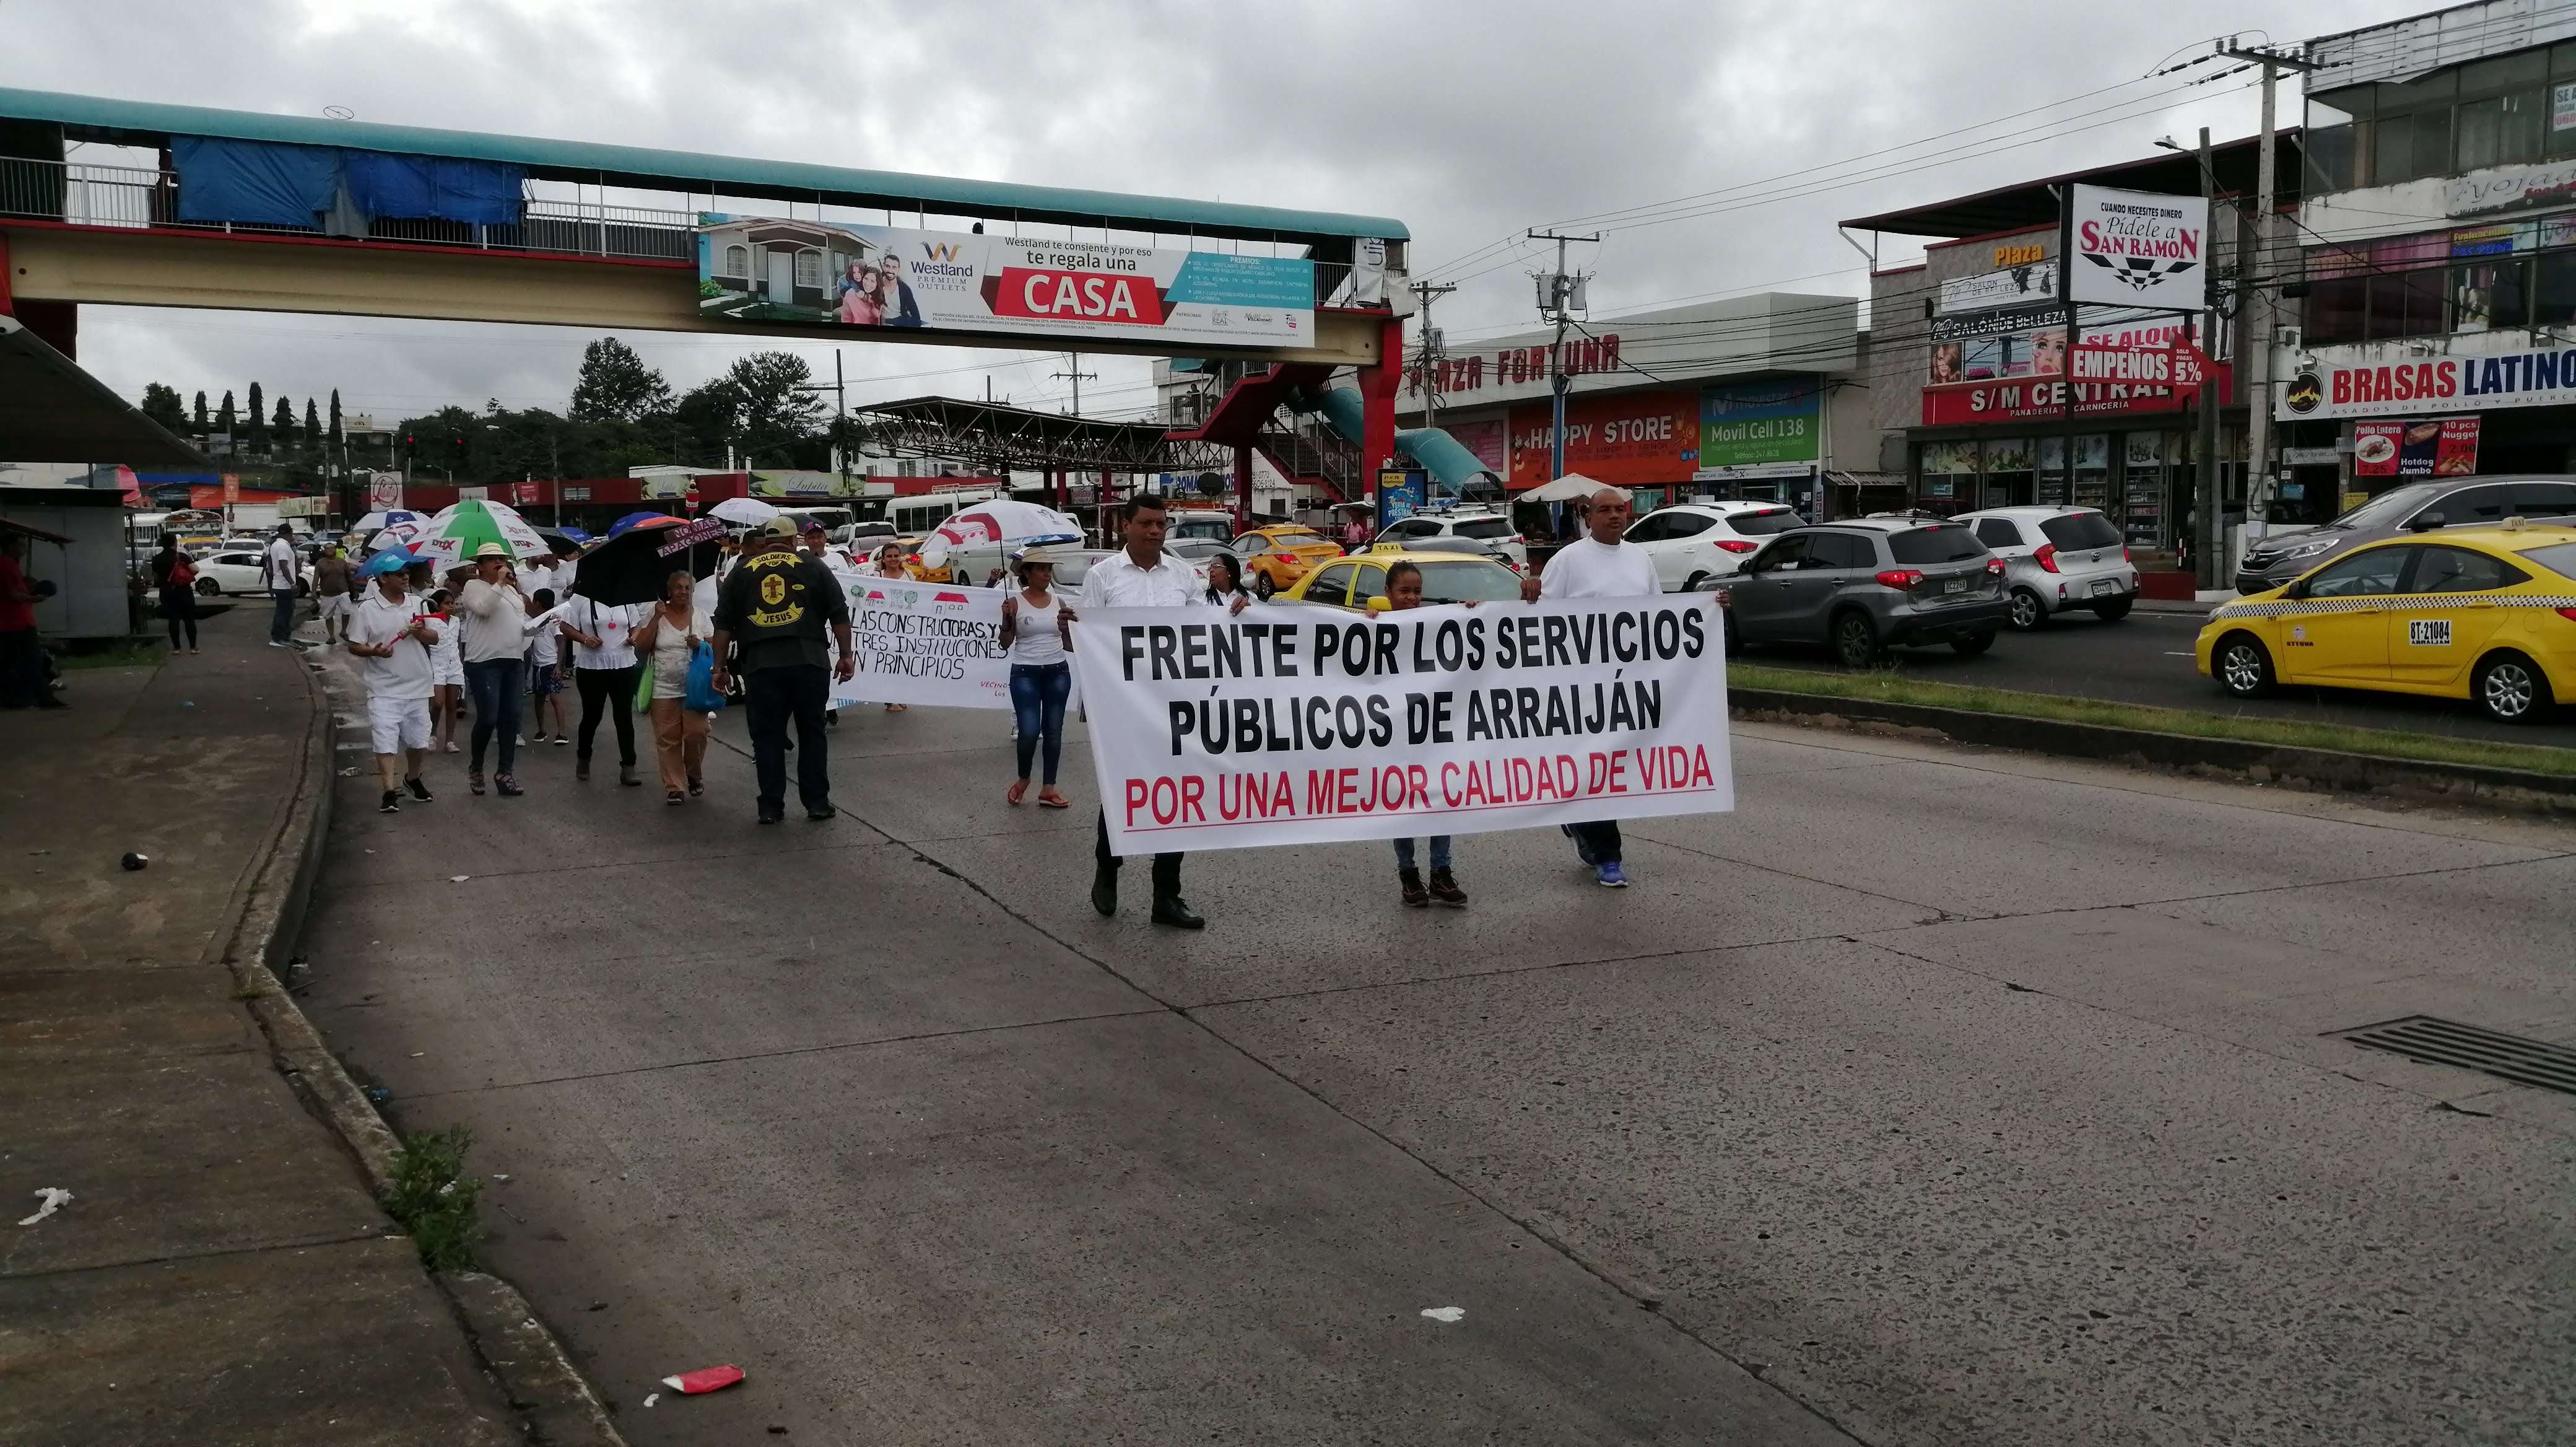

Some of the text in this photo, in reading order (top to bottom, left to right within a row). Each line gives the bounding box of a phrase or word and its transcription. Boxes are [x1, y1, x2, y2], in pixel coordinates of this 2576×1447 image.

[2101, 202, 2182, 219] CUANDO NECESITES DINERO
[2107, 217, 2175, 238] Pídele a
[1005, 238, 1050, 248] Westland
[1064, 243, 1109, 253] consiente
[1112, 247, 1116, 255] y
[1119, 248, 1134, 256] por
[2081, 220, 2199, 259] SAN RAMON
[1027, 250, 1136, 271] te regala una
[1230, 256, 1261, 265] PREMIOS:
[1995, 244, 2043, 267] Plaza
[911, 261, 972, 277] Westland
[916, 276, 967, 285] PREMIUM
[918, 284, 966, 292] OUTLETS
[1024, 274, 1137, 318] CASA
[1999, 316, 2013, 331] DE
[2016, 312, 2067, 328] BELLEZA
[2073, 347, 2169, 381] EMPEÑOS
[2175, 362, 2203, 382] 5%
[1413, 356, 1482, 398] PAZA
[2333, 361, 2456, 404] BRASAS
[1971, 385, 2021, 411] S/M
[2331, 406, 2390, 415] ASADOS
[2432, 400, 2481, 409] POLLO
[2515, 394, 2576, 403] PUERC
[2010, 401, 2129, 417] PANADERIA CARNICERIA
[1604, 416, 1671, 444] STORE
[1712, 418, 1804, 442] Movil Cell 138
[2356, 425, 2401, 434] Pollo Entero
[2400, 466, 2432, 474] Jumbo
[663, 526, 725, 556] APAGONES
[757, 554, 791, 563] SOLDIERS
[764, 611, 792, 624] JESUS
[2411, 621, 2450, 640] 8T-21084
[895, 636, 1009, 659] INSTITUCIONES
[1121, 610, 1704, 681] FRENTE POR LOS SERVICIOS
[875, 652, 964, 680] PRINCIPIOS
[1169, 669, 1660, 755] PÚBLICOS DE ARRAIJÁN
[1126, 745, 1713, 826] POR UNA MEJOR CALIDAD DE VIDA
